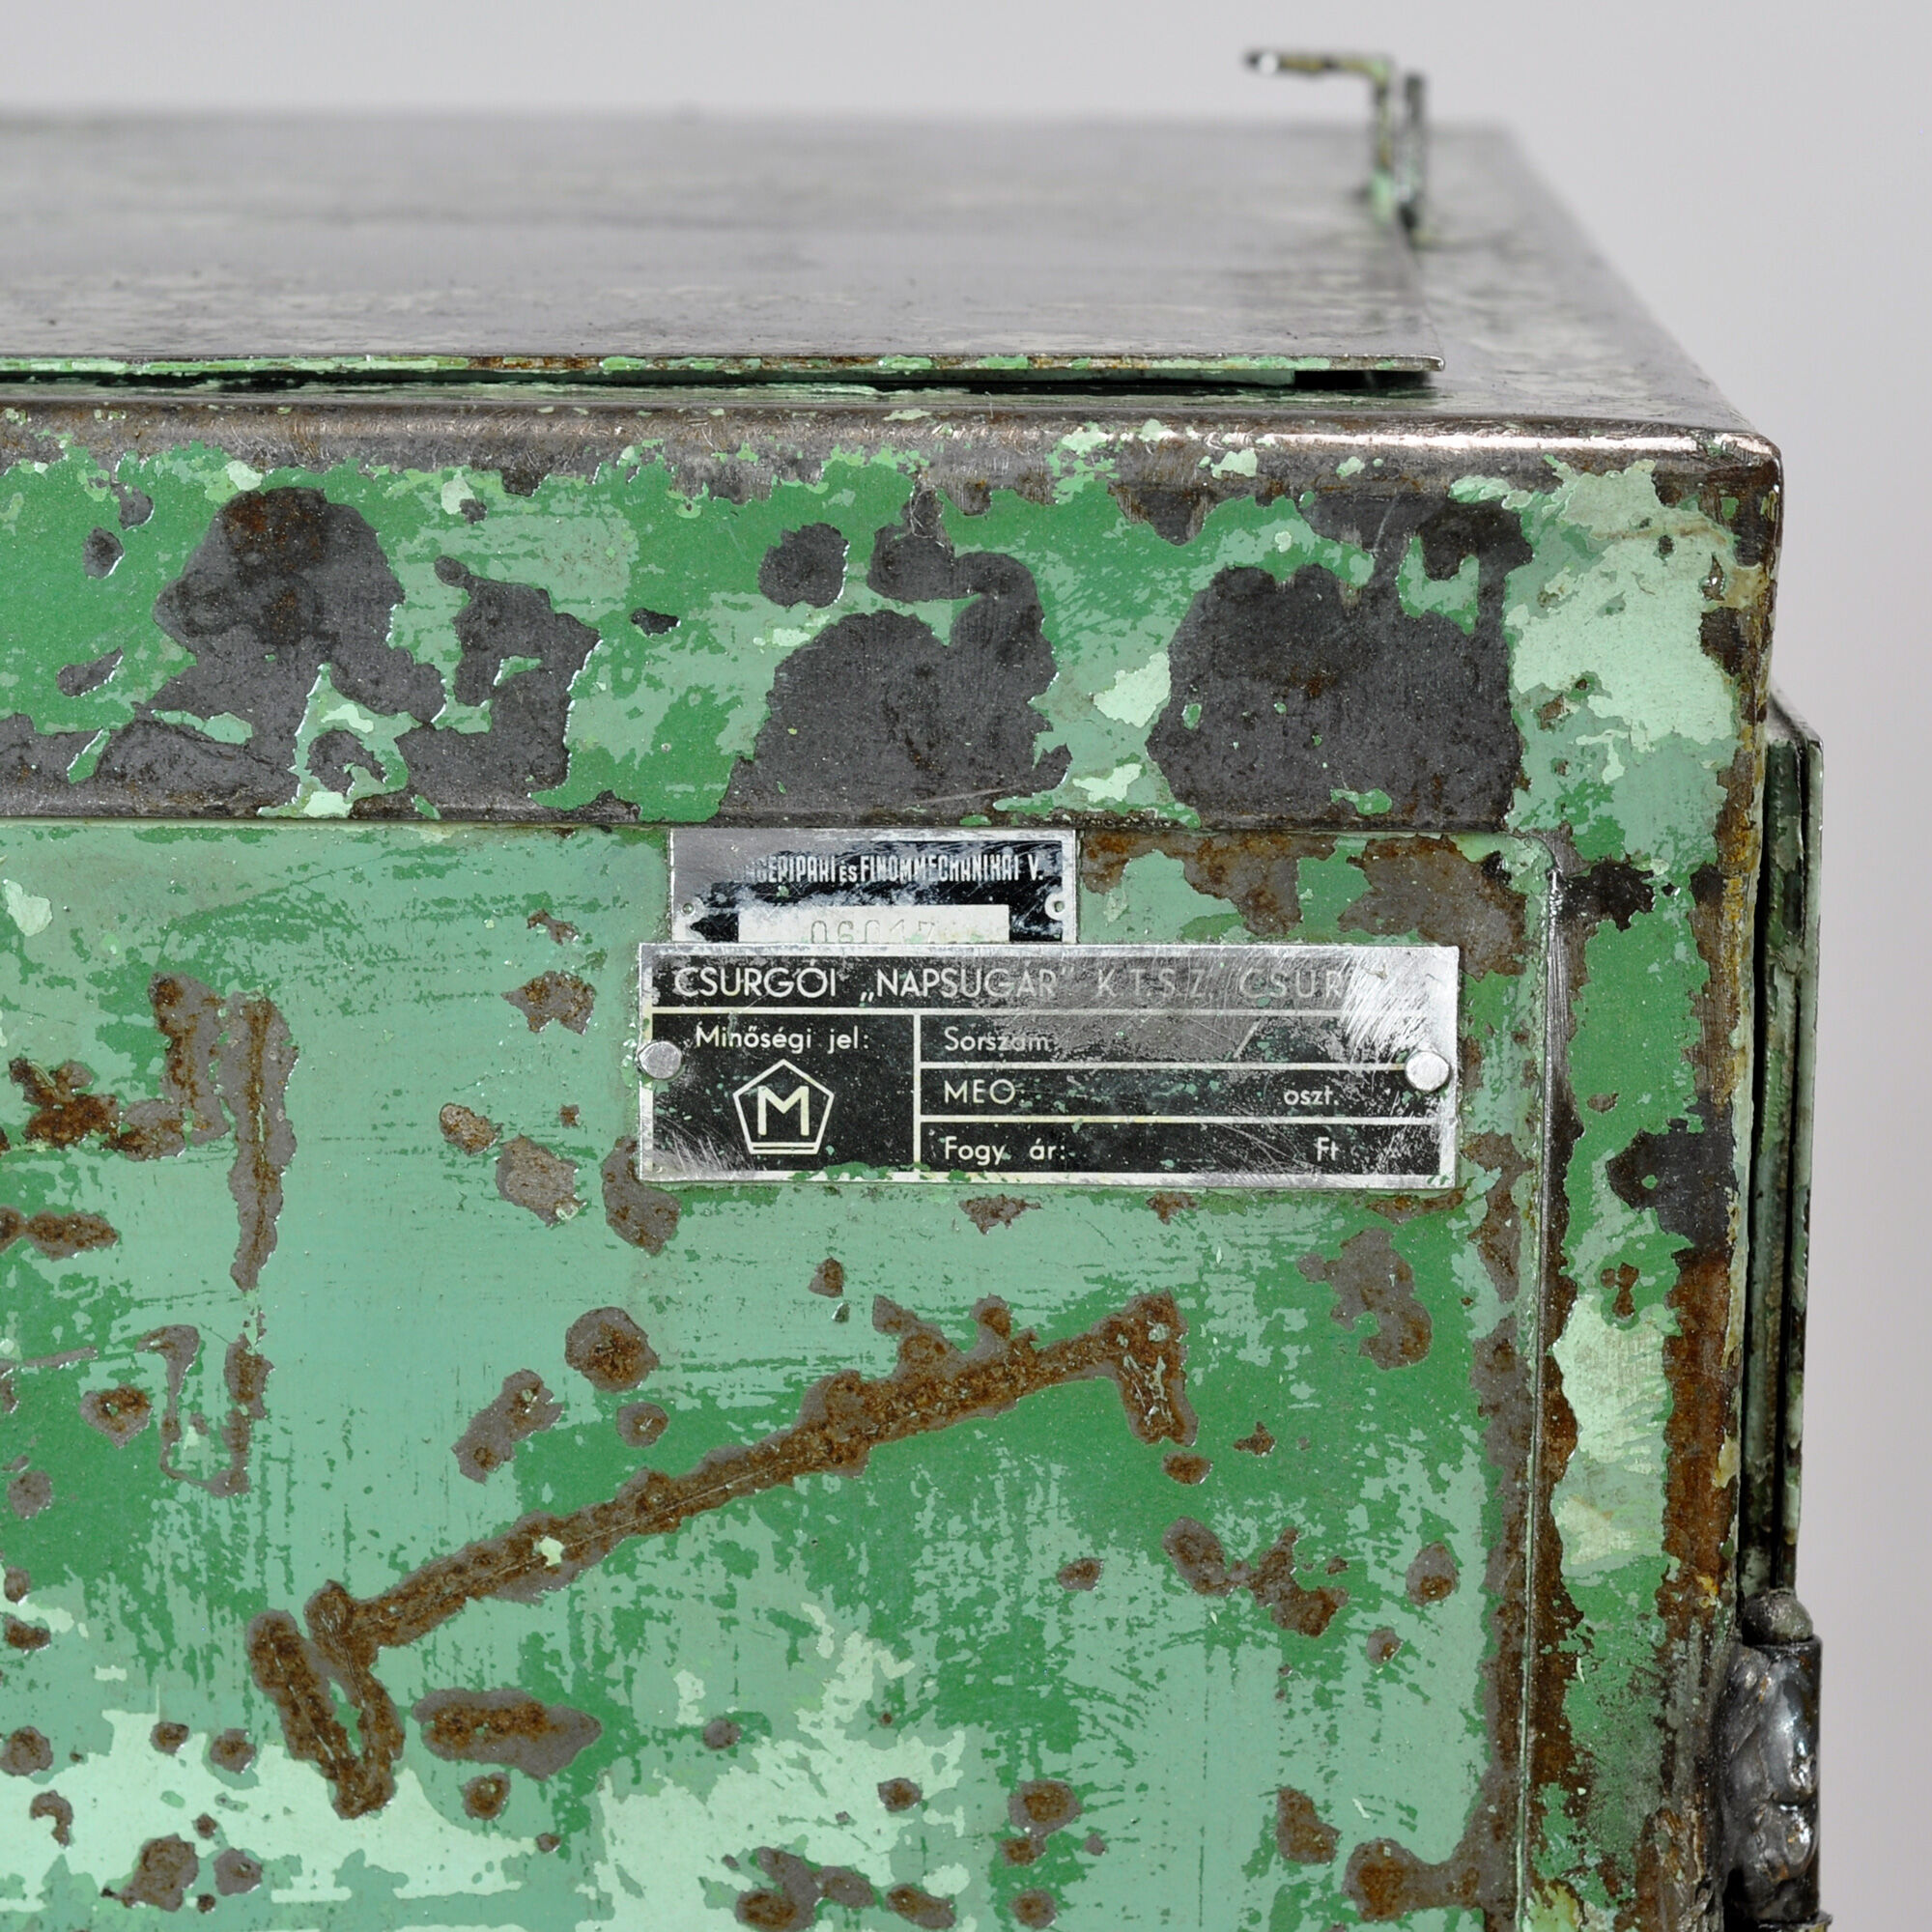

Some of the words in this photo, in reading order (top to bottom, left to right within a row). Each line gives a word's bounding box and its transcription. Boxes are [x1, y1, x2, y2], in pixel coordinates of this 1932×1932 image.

[674, 959, 836, 998] CSURGÓI
[696, 1025, 812, 1054] Minőségi
[828, 1025, 869, 1054] jel:
[757, 1085, 810, 1136] M
[1284, 1088, 1339, 1106] oszt.
[1029, 1136, 1066, 1161] ár:
[1317, 1137, 1338, 1160] Ft
